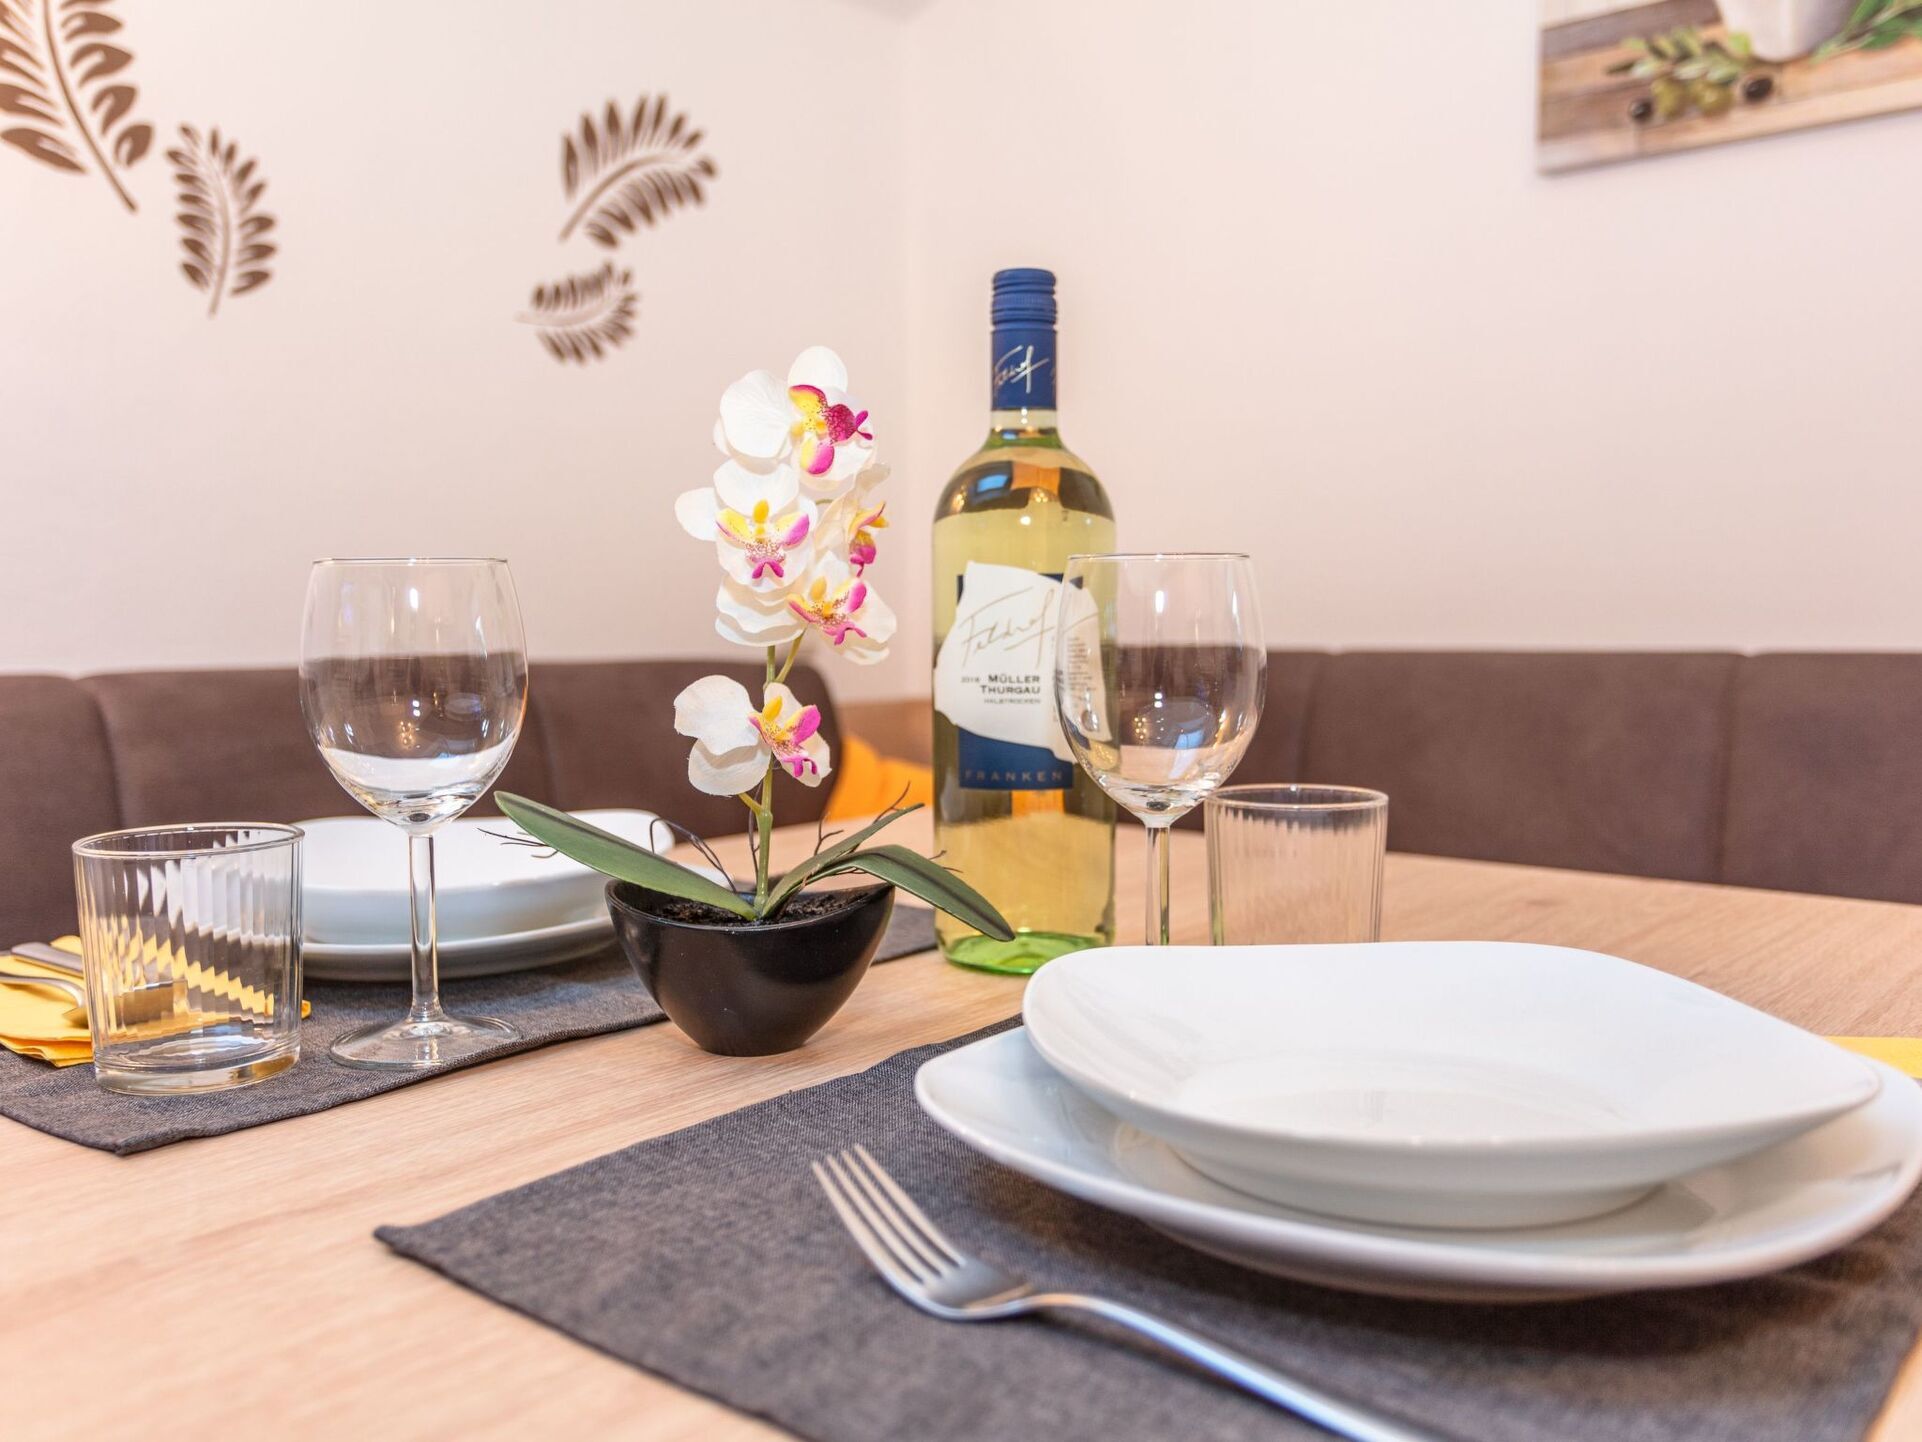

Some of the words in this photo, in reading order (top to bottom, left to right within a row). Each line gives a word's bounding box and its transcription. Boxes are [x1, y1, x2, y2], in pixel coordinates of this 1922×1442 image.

[988, 674, 1040, 683] MÜLLER
[980, 685, 1040, 694] THURGAU
[965, 771, 1063, 783] FRANKEN
